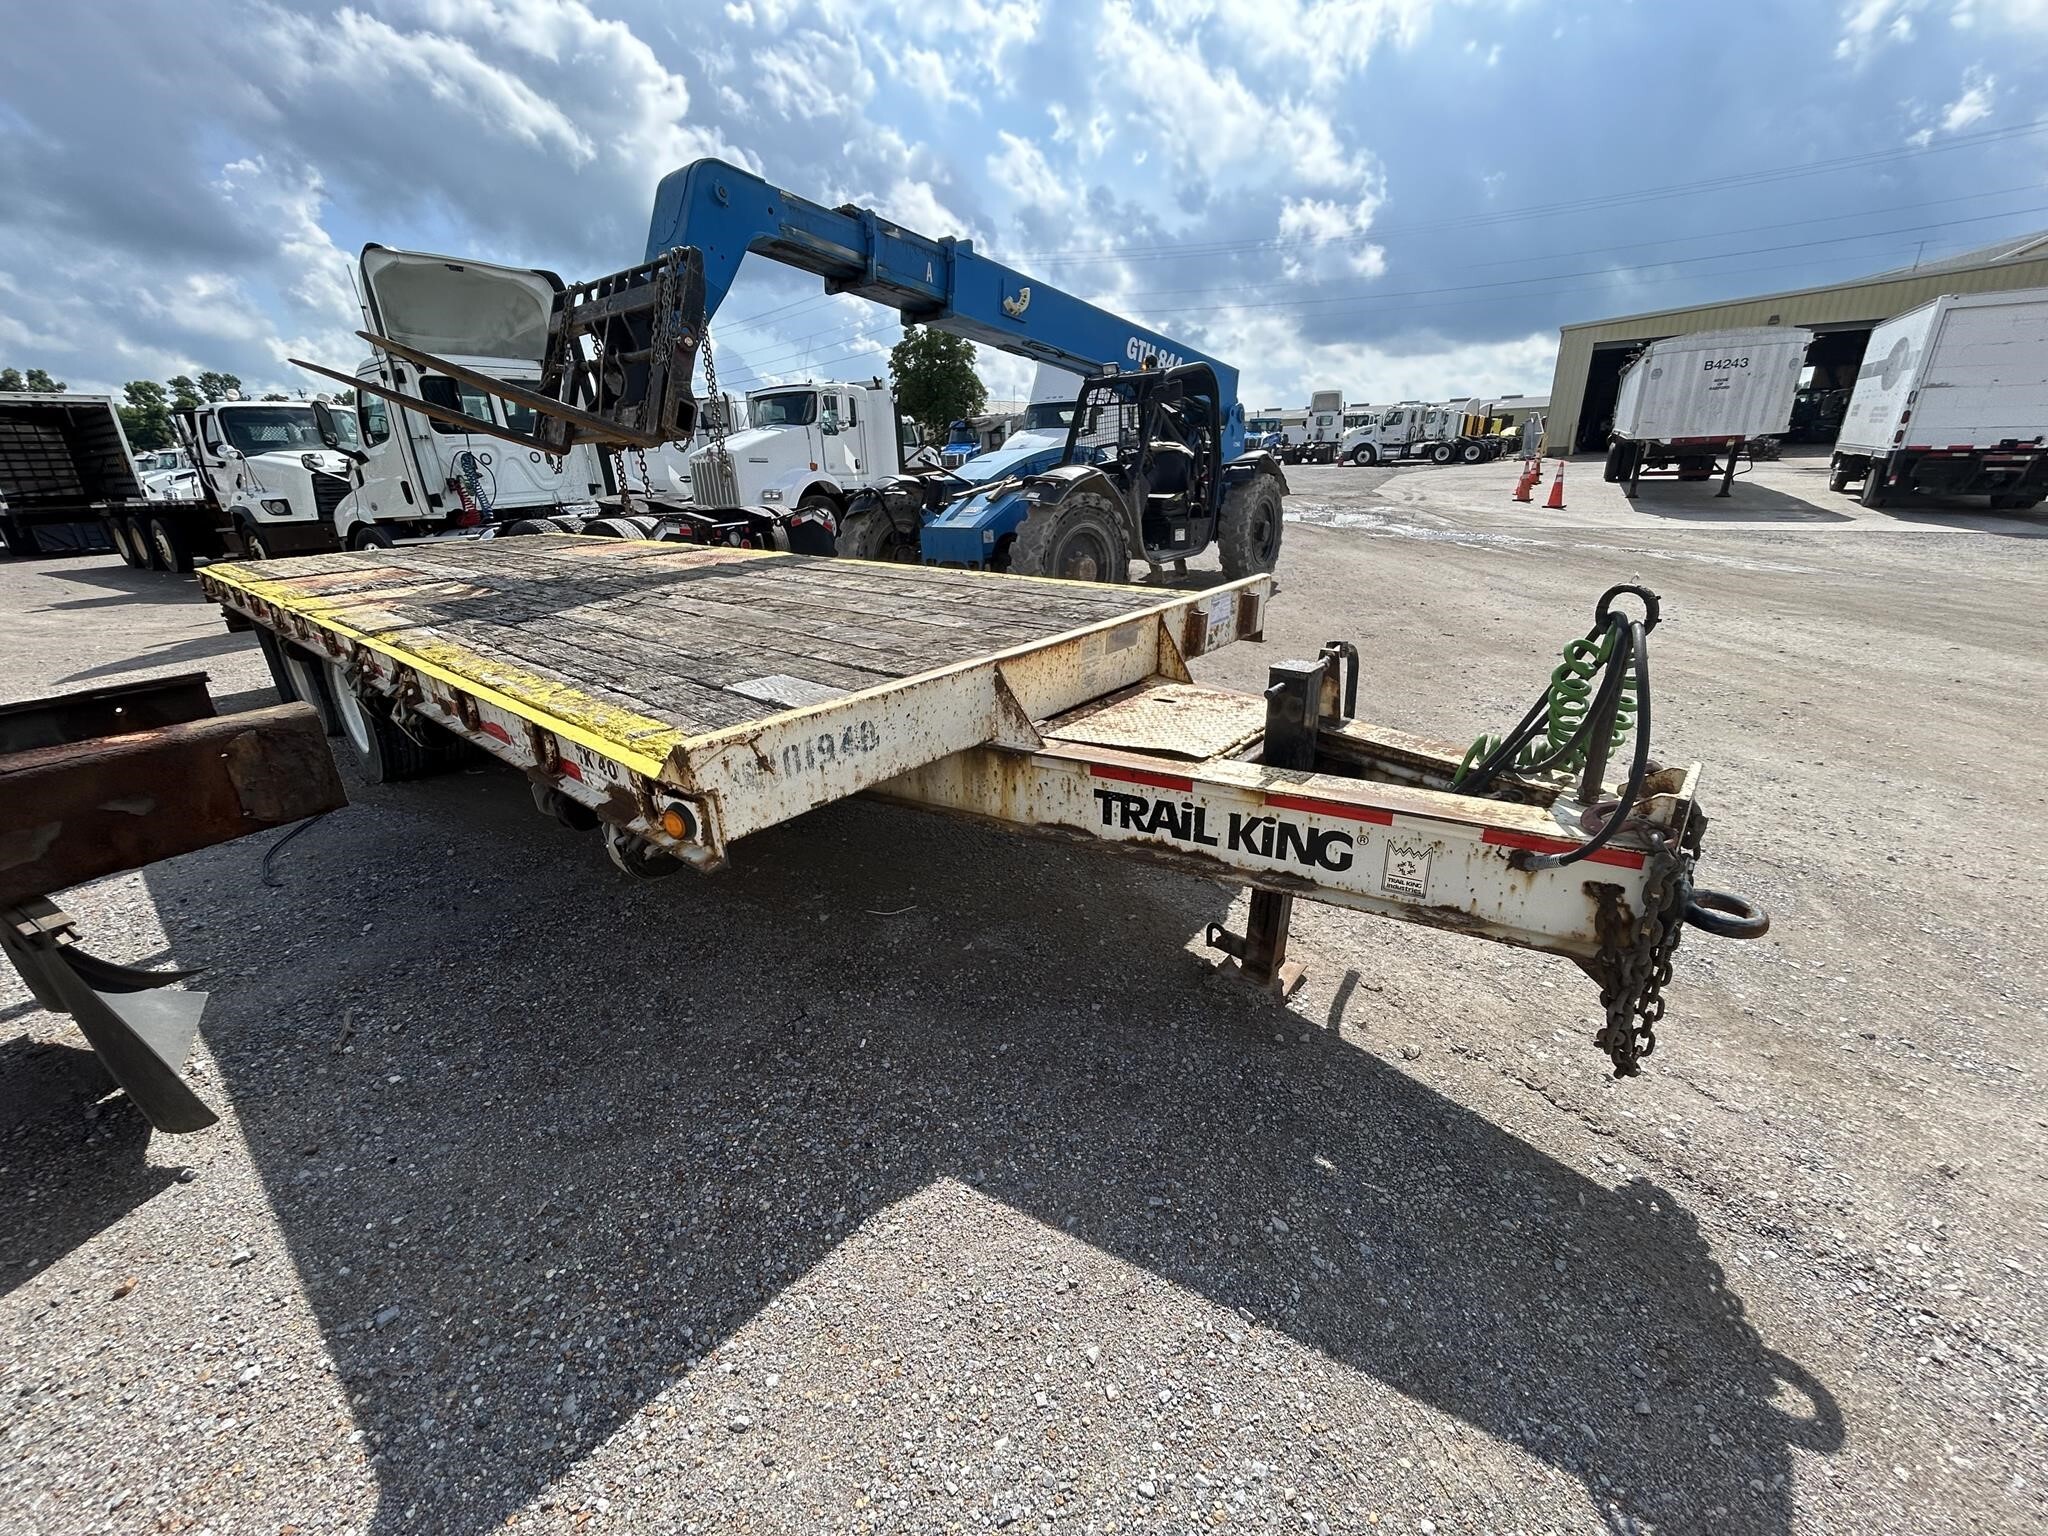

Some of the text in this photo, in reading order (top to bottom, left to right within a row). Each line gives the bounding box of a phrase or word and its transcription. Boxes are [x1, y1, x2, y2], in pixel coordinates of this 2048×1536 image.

[926, 261, 933, 283] A
[1126, 336, 1156, 363] GTH
[1704, 357, 1749, 370] B4243
[599, 756, 618, 780] 40
[1386, 883, 1421, 894] industries
